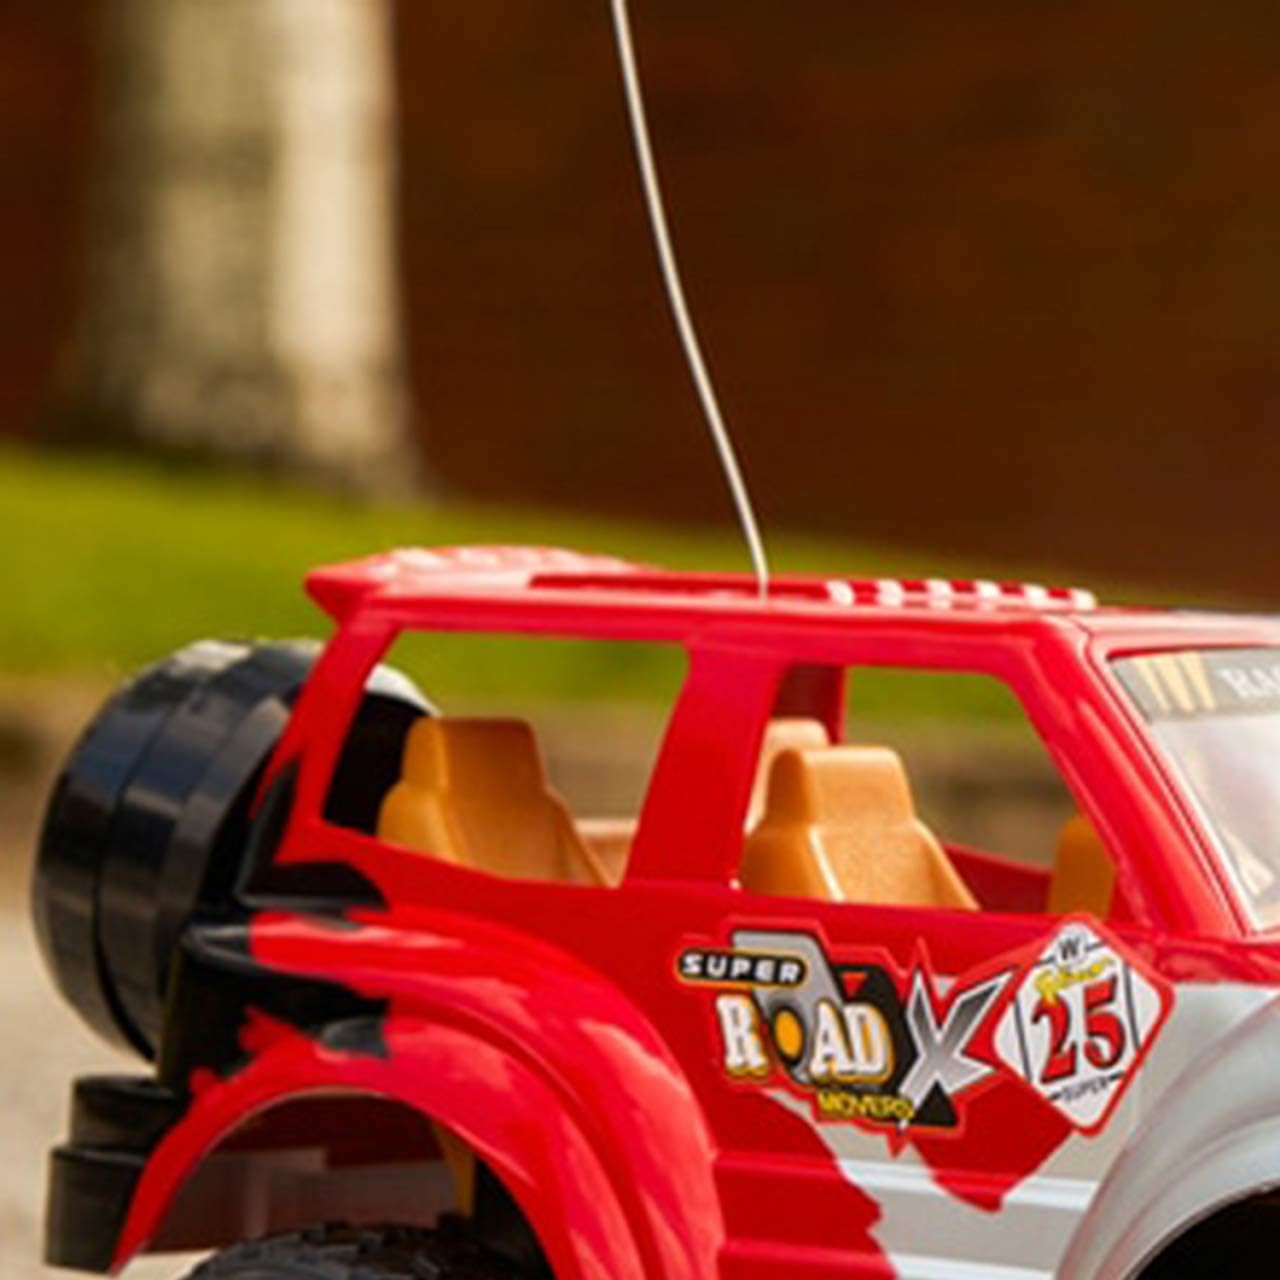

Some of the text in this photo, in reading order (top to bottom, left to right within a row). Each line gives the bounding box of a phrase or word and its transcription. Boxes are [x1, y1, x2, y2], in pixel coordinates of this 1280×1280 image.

[681, 950, 800, 983] SUPER
[715, 993, 895, 1082] ROAD
[1031, 972, 1127, 1085] 25
